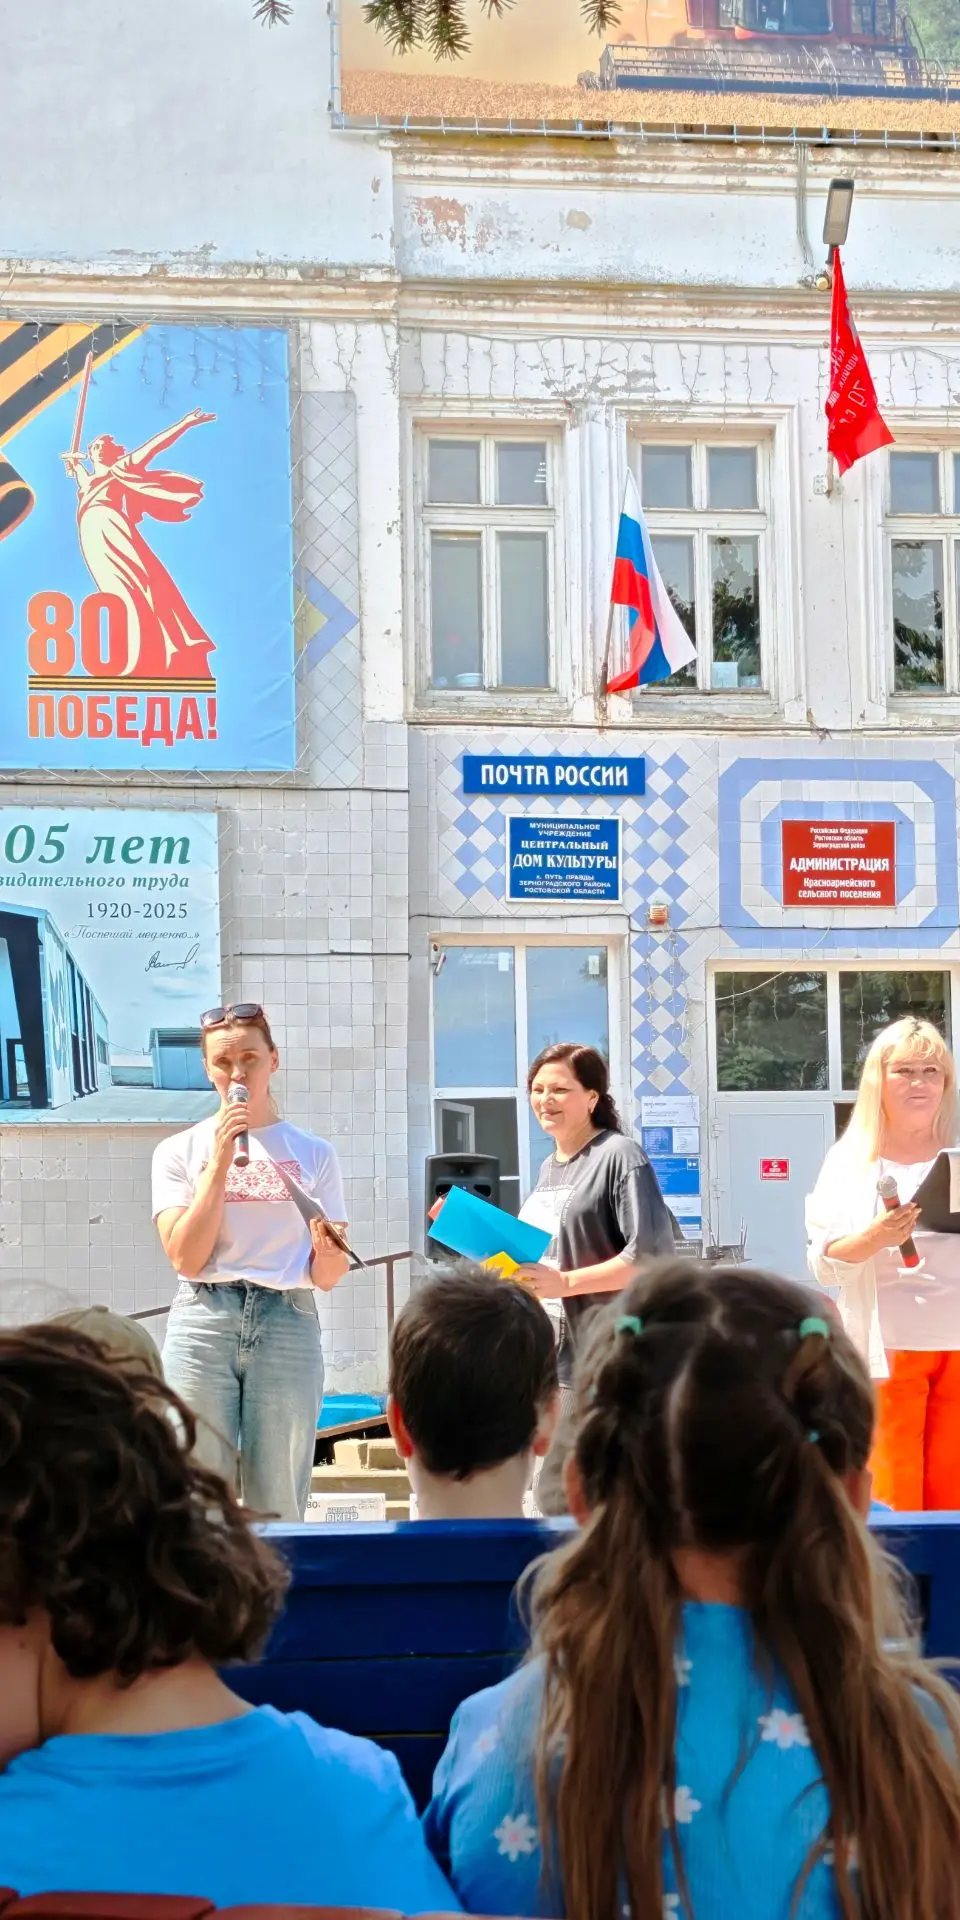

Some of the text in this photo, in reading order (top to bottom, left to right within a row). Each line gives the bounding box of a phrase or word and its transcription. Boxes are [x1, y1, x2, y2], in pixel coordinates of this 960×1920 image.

[27, 590, 128, 677] 80
[28, 694, 218, 747] ПОБЕДА!
[481, 764, 628, 786] ПОЧТА РОССИИ
[530, 822, 600, 831] МУНИЦИПАЛЬНОЕ
[538, 830, 592, 838] УЧРЕЖДЕНИЕ
[85, 836, 191, 864] лет
[521, 840, 608, 850] ЦЕНТРАЛЬНЫЙ
[512, 854, 617, 869] ДОМ КУЛЬТУРЫ
[789, 857, 889, 873] АДМИНИСТРАЦИЯ
[132, 873, 189, 890] труда
[803, 878, 876, 889] Красноармейского
[798, 890, 881, 898] сельского поселения
[87, 902, 188, 919] 1920-2025
